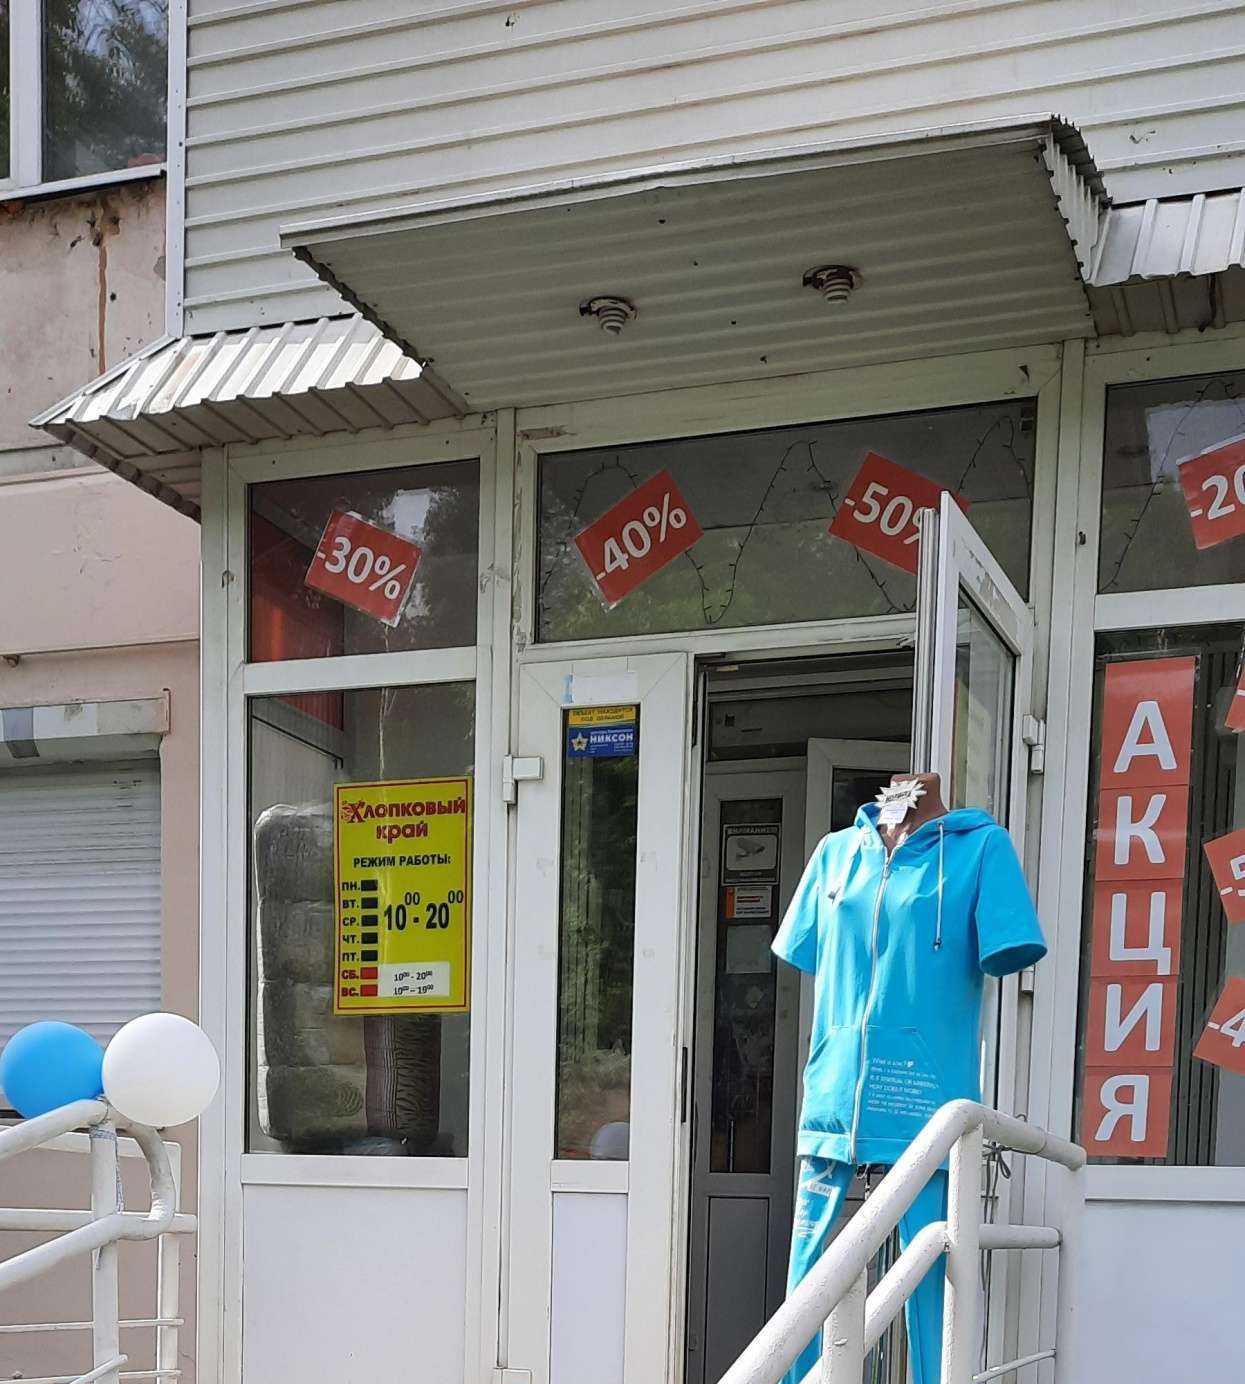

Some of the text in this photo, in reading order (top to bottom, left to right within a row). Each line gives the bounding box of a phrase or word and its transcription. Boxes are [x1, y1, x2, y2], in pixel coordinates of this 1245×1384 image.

[596, 492, 687, 581] -40%
[316, 536, 407, 600] -30%
[589, 733, 633, 743] НИКСОН
[376, 820, 428, 844] край
[353, 853, 451, 868] РЕЖИМ РАБОТЫ:
[341, 881, 360, 891] ПН.
[342, 899, 360, 909] ВТ.
[342, 916, 360, 926] СР.
[1094, 699, 1178, 1143] АКЦИЯ
[342, 934, 360, 944] ЧТ.
[342, 952, 360, 962] ПТ.
[341, 969, 360, 980] СБ.
[341, 987, 360, 997] ВС.
